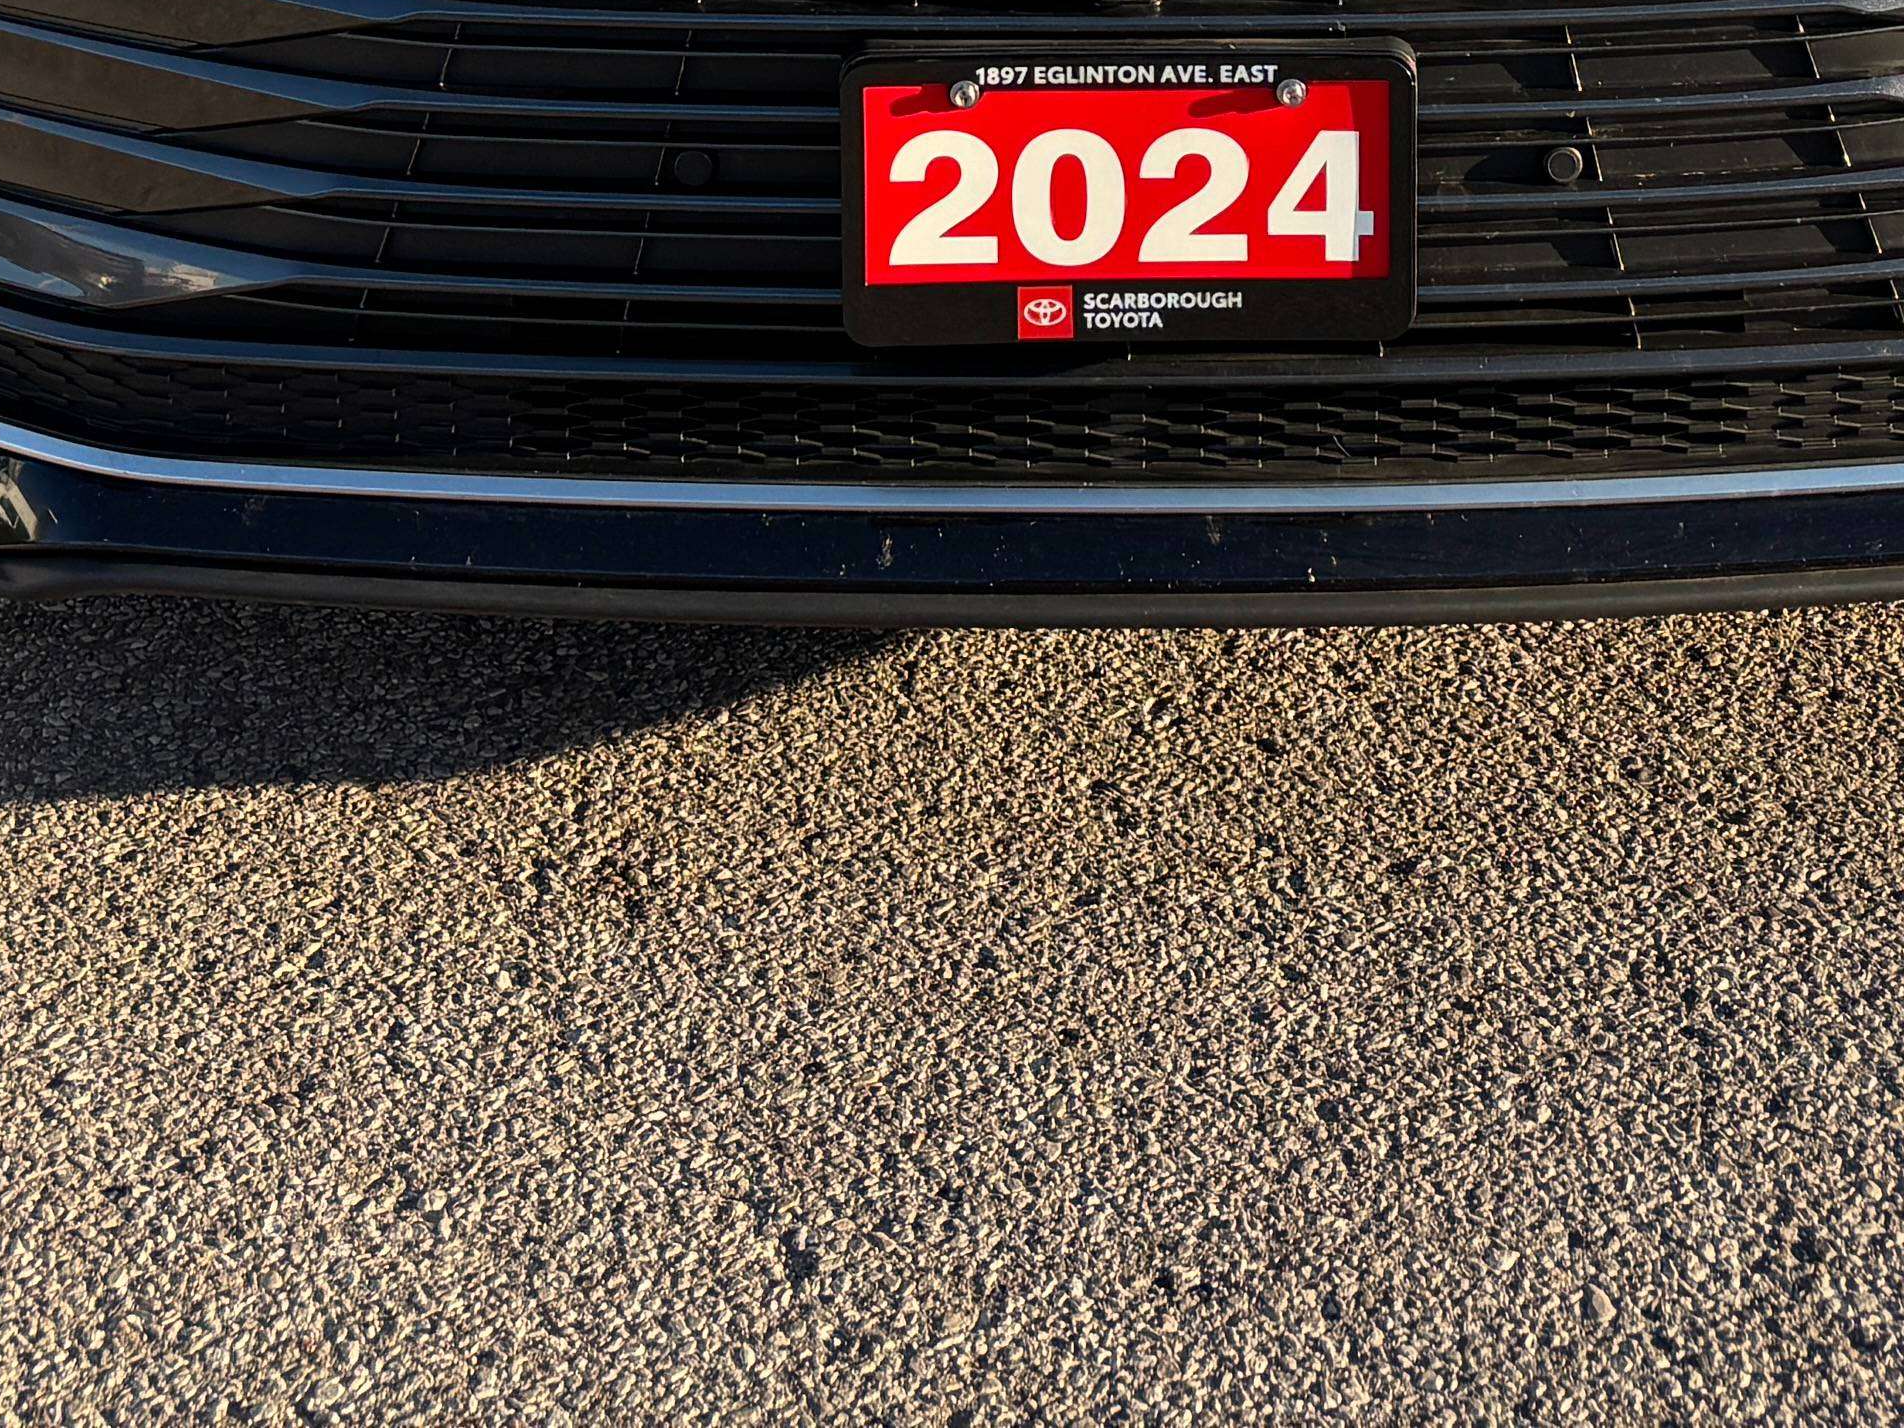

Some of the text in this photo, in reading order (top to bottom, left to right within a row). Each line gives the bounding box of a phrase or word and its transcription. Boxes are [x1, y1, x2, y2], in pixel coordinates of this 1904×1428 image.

[975, 63, 1278, 85] 1897 EGLINTON AVE. EAST
[888, 127, 1375, 267] 2024
[1083, 291, 1243, 311] SCARBOROUGH
[1083, 311, 1164, 330] TOYOTA
